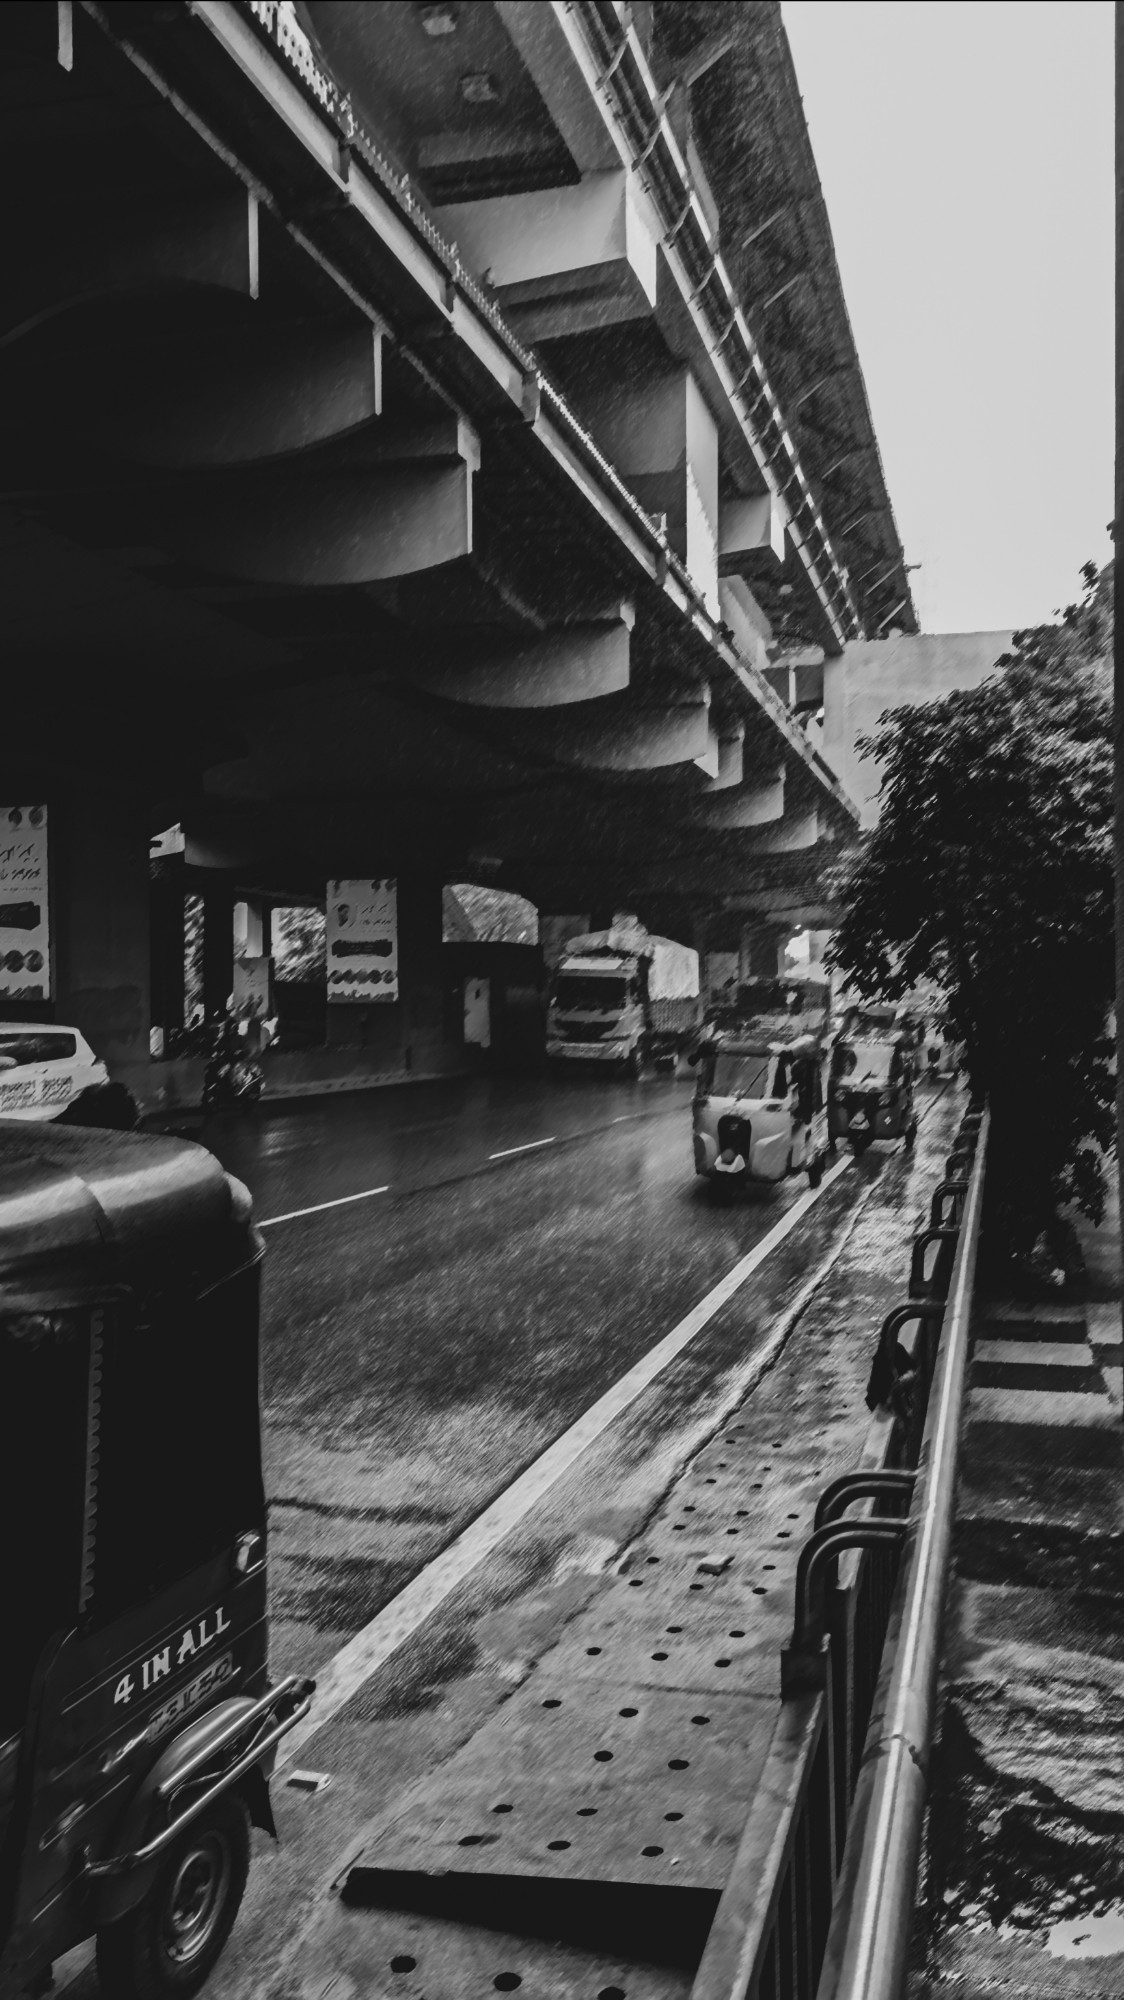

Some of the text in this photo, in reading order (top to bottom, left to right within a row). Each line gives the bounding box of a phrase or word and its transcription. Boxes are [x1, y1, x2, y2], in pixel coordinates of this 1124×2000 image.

[114, 1673, 135, 1704] 4
[142, 1646, 171, 1690] IN
[177, 1606, 231, 1664] ALL
